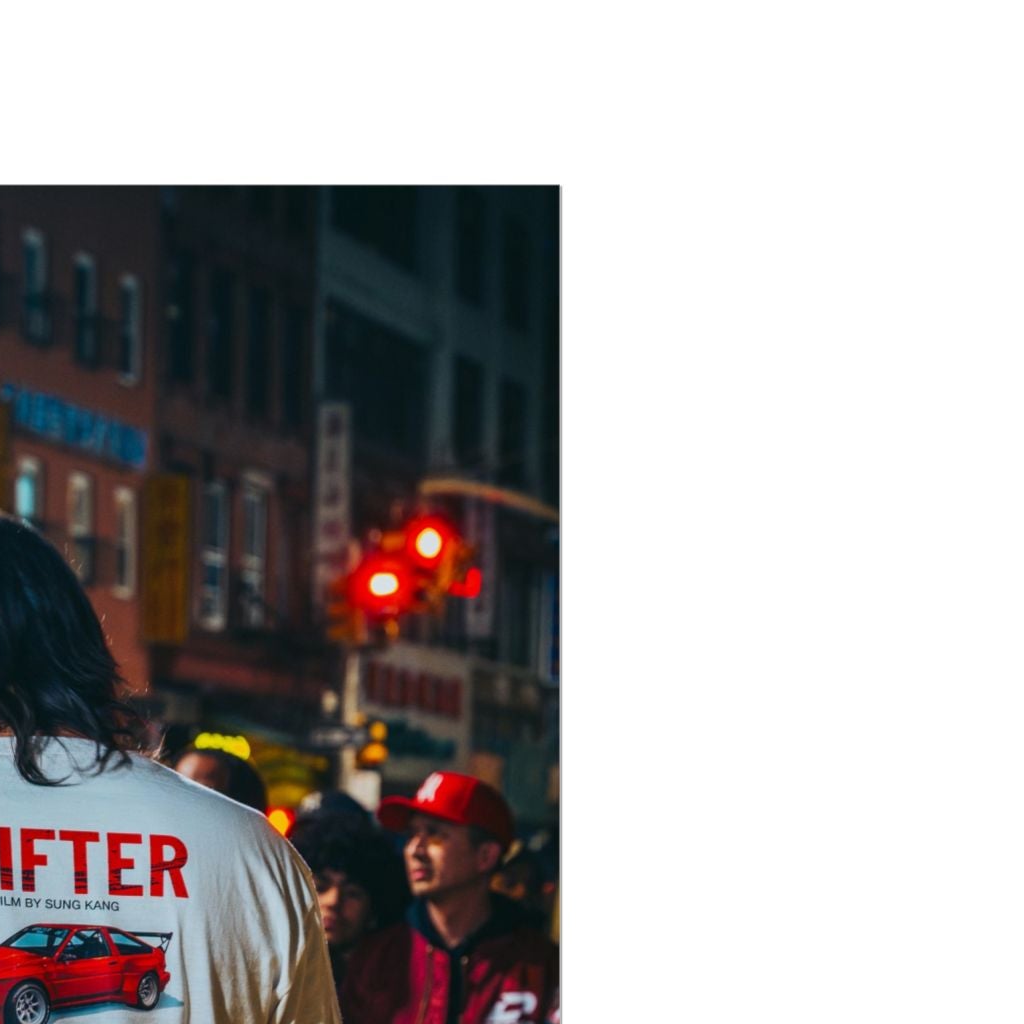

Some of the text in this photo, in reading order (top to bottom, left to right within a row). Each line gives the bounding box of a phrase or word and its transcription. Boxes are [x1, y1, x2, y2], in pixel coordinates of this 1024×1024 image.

[25, 898, 41, 908] BY
[45, 898, 81, 910] SUNG
[85, 900, 120, 912] KANG
